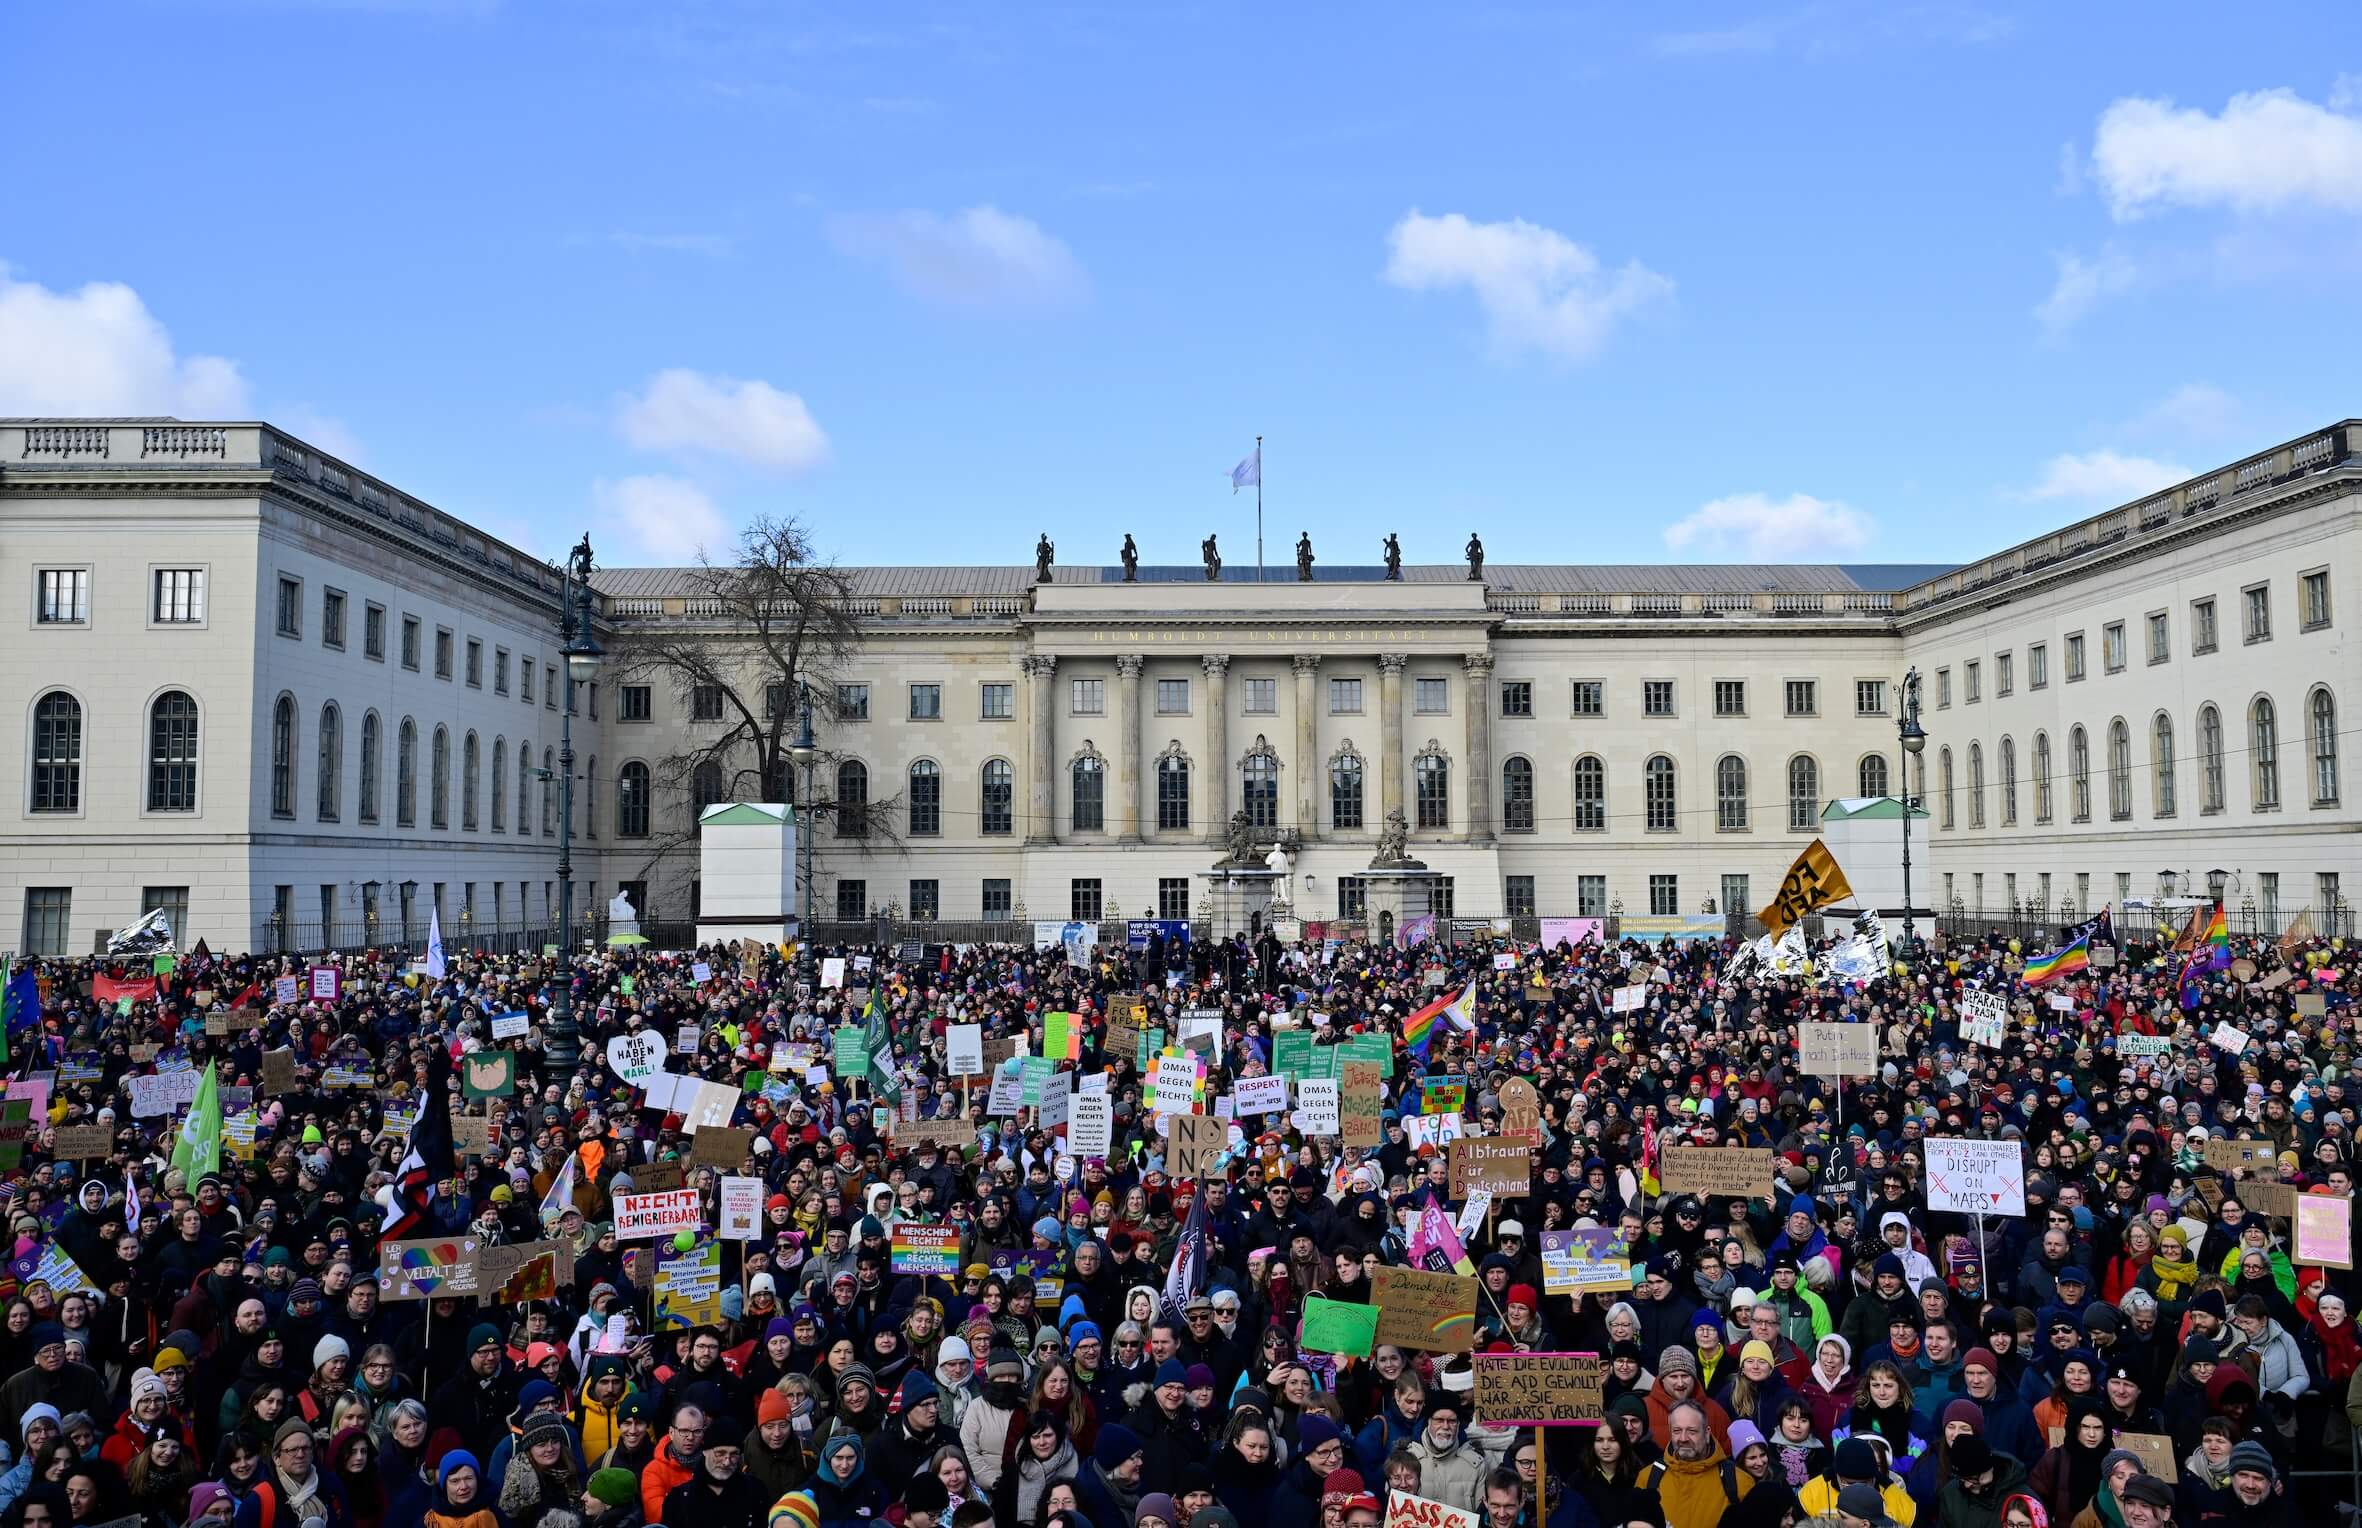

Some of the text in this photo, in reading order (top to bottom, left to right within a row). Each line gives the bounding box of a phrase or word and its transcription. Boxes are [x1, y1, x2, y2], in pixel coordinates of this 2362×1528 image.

[1094, 631, 1426, 641] HUMBOLDT UNIVERSITAET
[1963, 989, 2005, 1011] SEPARATE
[1180, 1009, 1223, 1018] NIE WIEDER!
[1970, 1005, 1996, 1020] TRASH
[1815, 1028, 1843, 1041] Putin
[625, 1037, 645, 1049] WIR
[617, 1045, 655, 1060] HABEN
[631, 1055, 646, 1067] DIE
[1162, 1062, 1192, 1074] OMAS
[137, 1072, 196, 1091] NIE WIEDER
[1046, 1079, 1065, 1090] OMAS
[1159, 1076, 1192, 1088] GEGEN
[1344, 1068, 1379, 1089] JEDER
[1238, 1079, 1281, 1092] RESPEKT
[1304, 1086, 1332, 1094] OMAS
[1043, 1090, 1067, 1102] GEGEN
[1156, 1090, 1193, 1103] RECHTS
[1042, 1102, 1068, 1114] RECHTS
[1417, 1114, 1452, 1131] FCK
[1507, 1106, 1540, 1130] AFD
[1420, 1129, 1454, 1144] AFD
[1456, 1143, 1527, 1161] Albtraum
[1971, 1142, 2019, 1152] BILLIONAIRES
[2209, 1142, 2239, 1151] Alles
[1664, 1150, 1683, 1160] Weil
[1685, 1151, 1737, 1164] nachhaltige
[1945, 1149, 1951, 1157] X
[1664, 1160, 1699, 1172] Offenheit
[1947, 1157, 1998, 1174] DISRUPT
[1665, 1171, 1696, 1180] weniger
[1700, 1171, 1734, 1181] Freiheit
[1456, 1178, 1529, 1194] Deutschland
[1681, 1180, 1745, 1190] sondern mehr
[1965, 1177, 1983, 1189] ON
[625, 1190, 697, 1212] NICHT
[618, 1207, 701, 1229] REMIGRIERBAR!
[899, 1227, 953, 1237] MENSCHEN
[906, 1237, 945, 1246] RECHTE
[911, 1245, 941, 1254] STATT
[906, 1254, 944, 1264] RECHTE
[1549, 1259, 1586, 1267] Menschlich.
[660, 1261, 699, 1271] Menschlich.
[898, 1263, 951, 1273] MENSCHEN
[679, 1278, 694, 1287] eine
[680, 1282, 716, 1294] gerechtere
[1390, 1272, 1459, 1295] Demokratie
[691, 1292, 709, 1300] Welt.
[1428, 1293, 1456, 1308] Liebe
[1476, 1356, 1598, 1374] HÄTTE DIE EVOLUTION
[1480, 1375, 1503, 1390] DIE
[1545, 1375, 1600, 1393] GEWOLLT,
[1480, 1389, 1554, 1404] WÄR SIE
[1476, 1401, 1605, 1422] RÜCKWÄRTS VERLAUFEN
